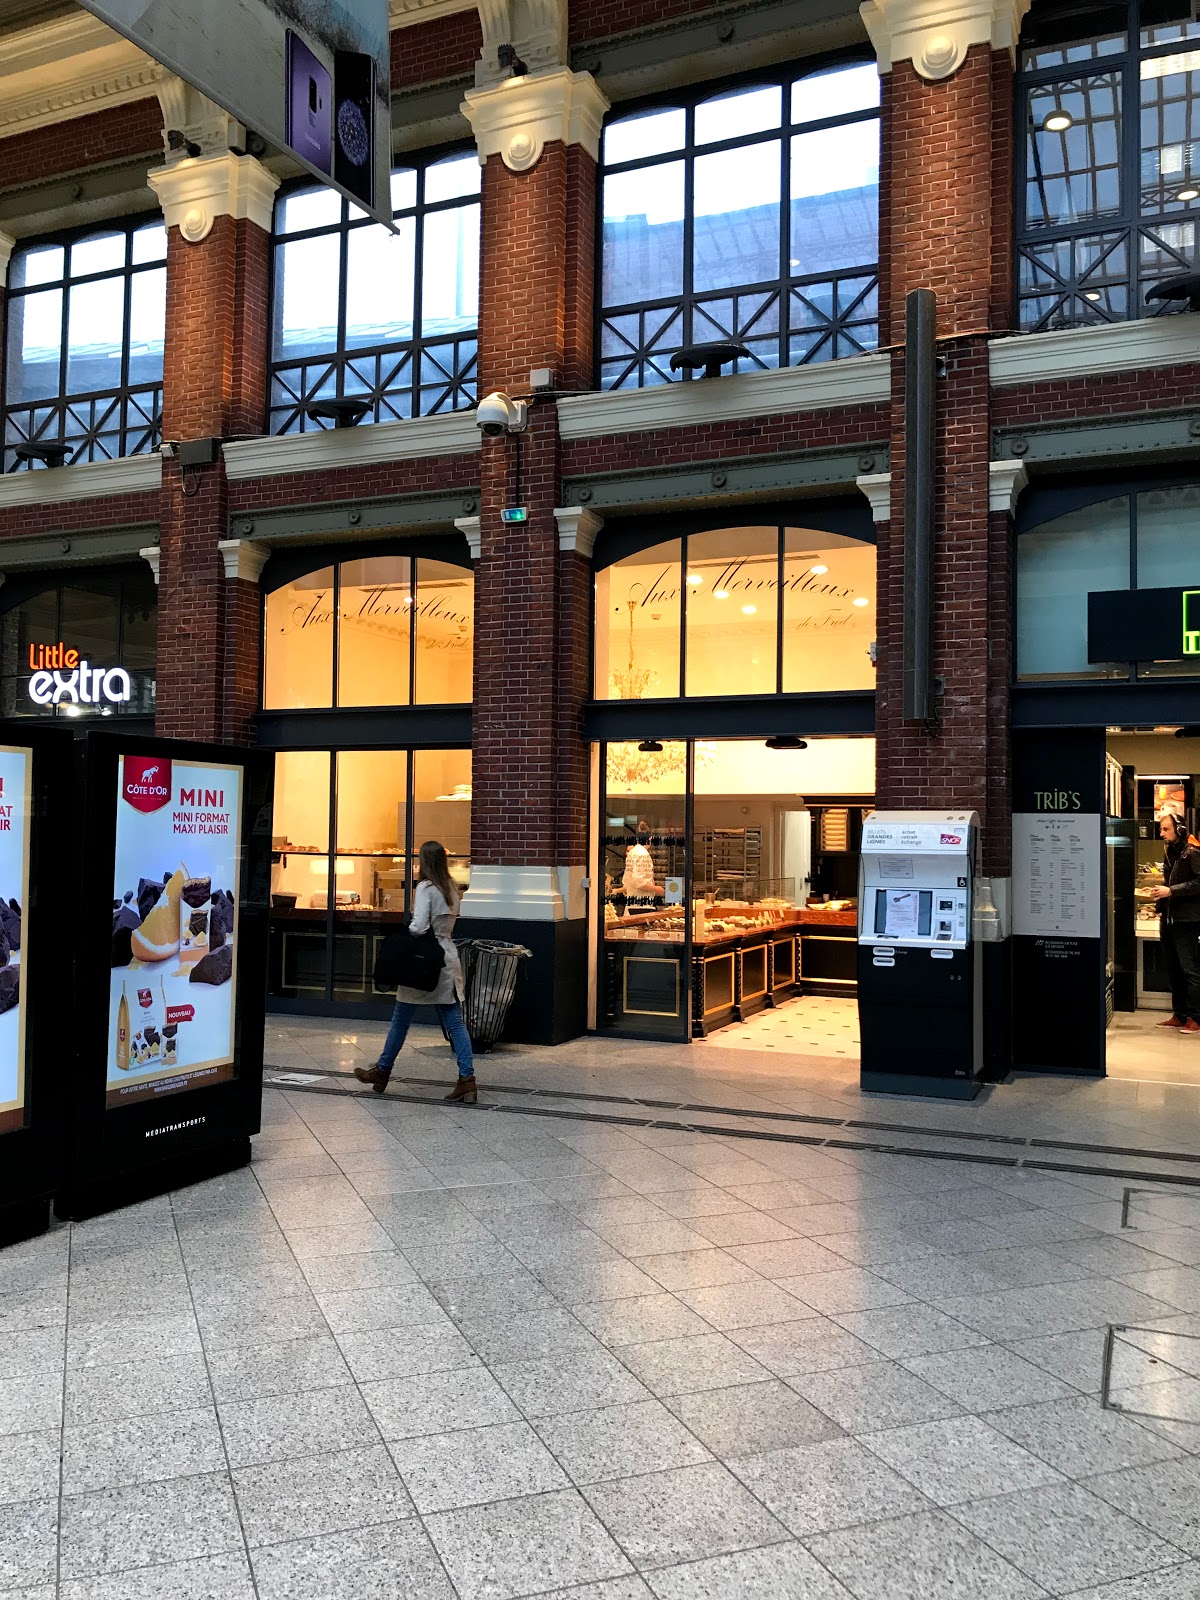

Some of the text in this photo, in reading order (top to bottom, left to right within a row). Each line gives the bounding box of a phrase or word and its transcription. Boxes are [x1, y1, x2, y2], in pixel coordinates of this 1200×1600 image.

[692, 556, 854, 599] Merveilleux
[813, 608, 855, 628] Fred
[29, 641, 79, 670] Little
[28, 660, 131, 705] extra
[126, 783, 168, 796] CÔTE D'OR
[180, 788, 224, 808] MINI
[1033, 788, 1082, 811] TRIB'S
[172, 811, 230, 824] MINI FORMAT
[173, 823, 229, 835] MAXI PLAISIR
[168, 1009, 191, 1019] NOUVEAU
[145, 1116, 206, 1138] MEDIATRANSPORTS
